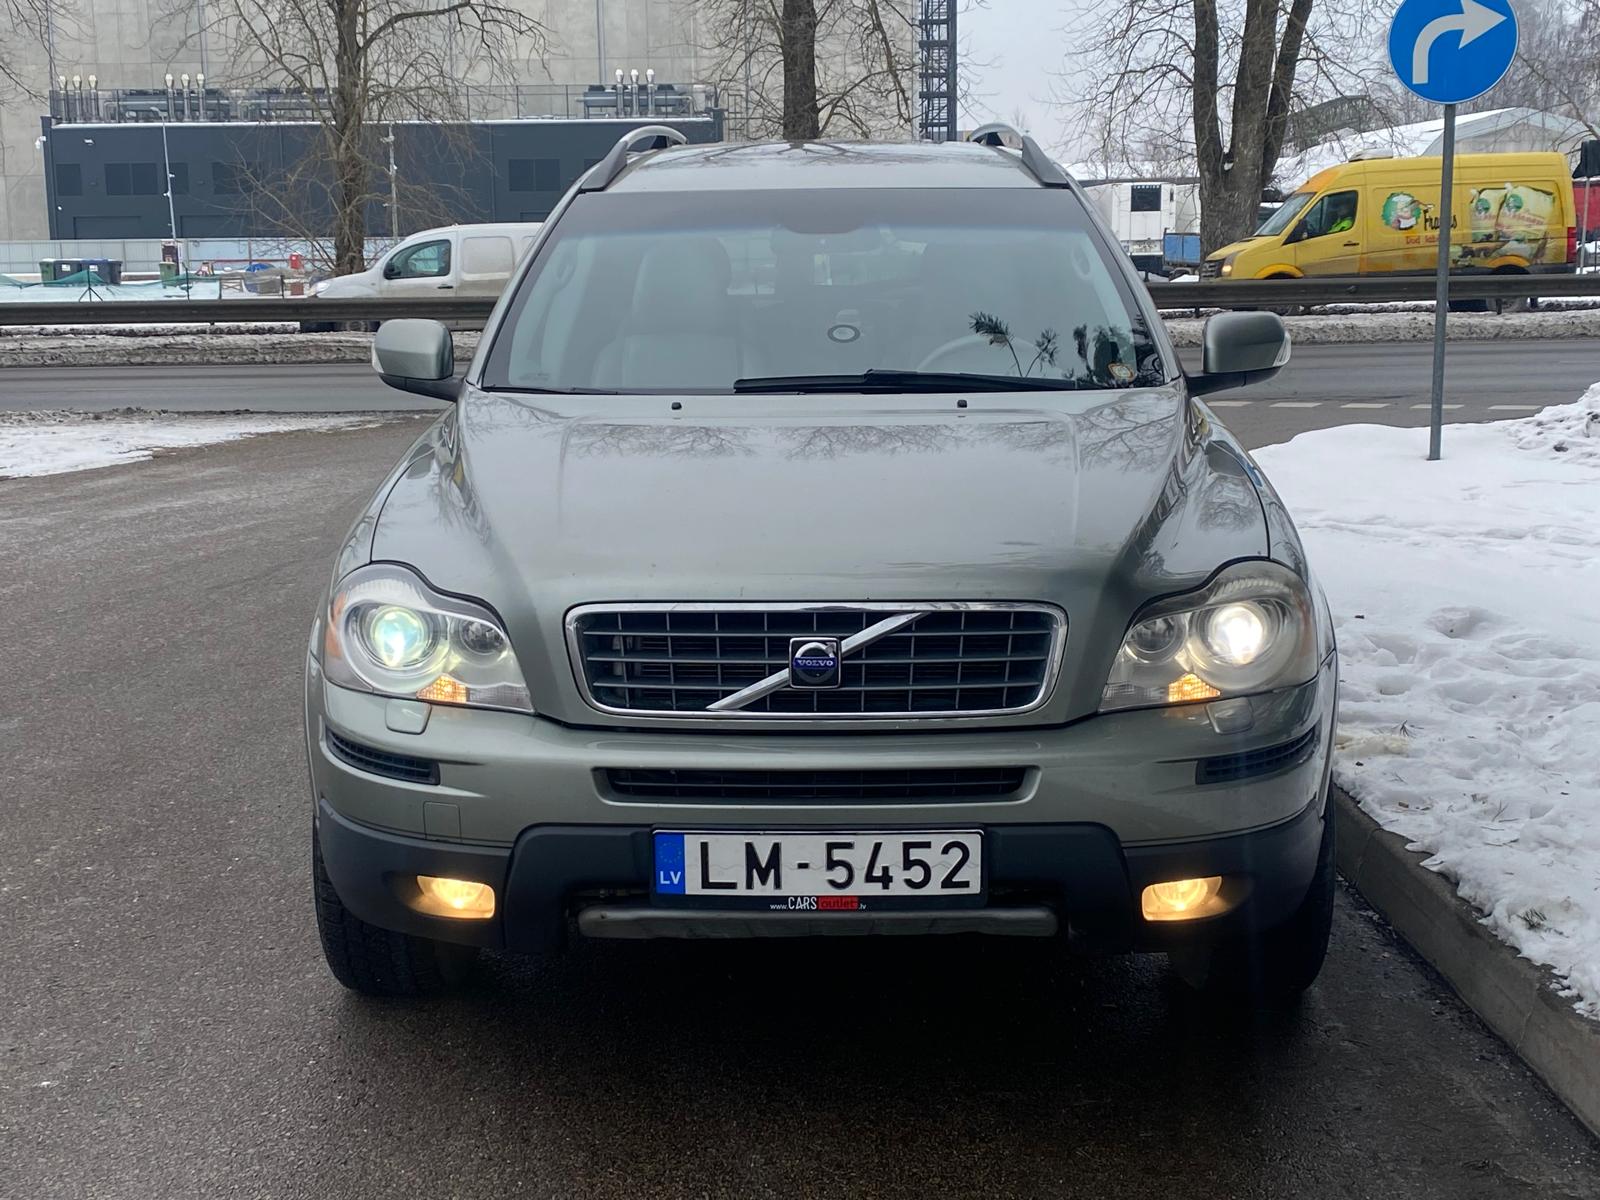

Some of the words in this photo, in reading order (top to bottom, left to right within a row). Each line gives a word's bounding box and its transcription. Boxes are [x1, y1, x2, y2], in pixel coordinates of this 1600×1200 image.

[797, 659, 834, 667] VOLVO
[699, 840, 971, 891] LM-5452
[659, 870, 682, 885] LV
